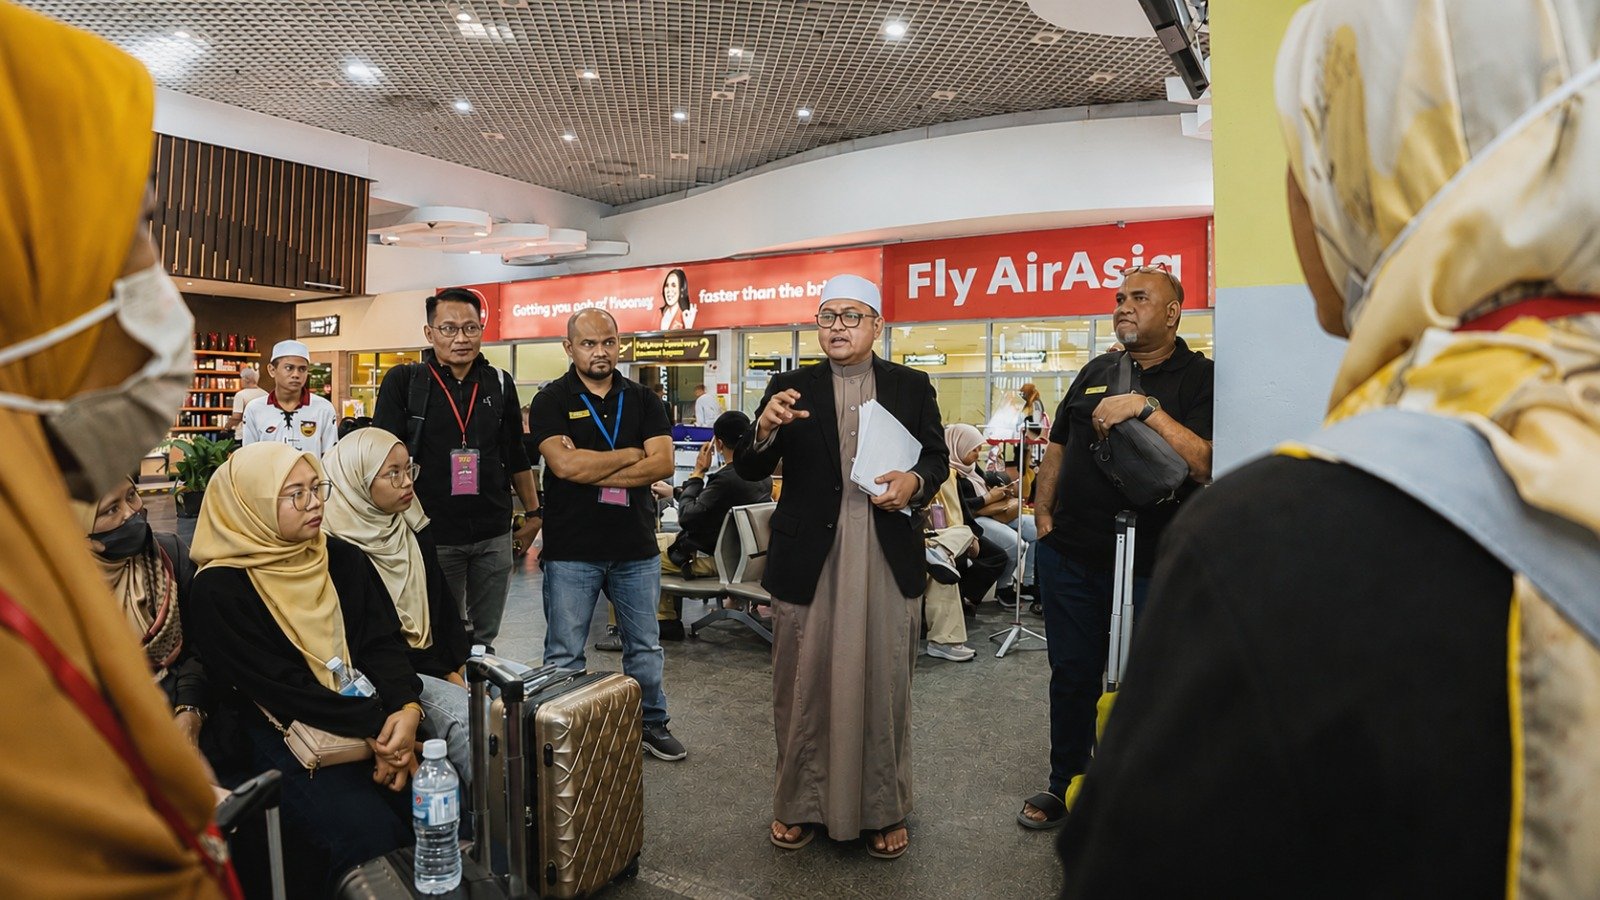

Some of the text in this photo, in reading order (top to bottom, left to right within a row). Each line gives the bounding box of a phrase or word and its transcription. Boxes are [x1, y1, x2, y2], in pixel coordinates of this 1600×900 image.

[908, 258, 977, 306] Fly
[513, 303, 550, 317] Getting
[552, 303, 571, 317] you
[699, 289, 739, 303] faster
[742, 286, 776, 301] than
[778, 283, 804, 298] the
[699, 338, 710, 358] 2
